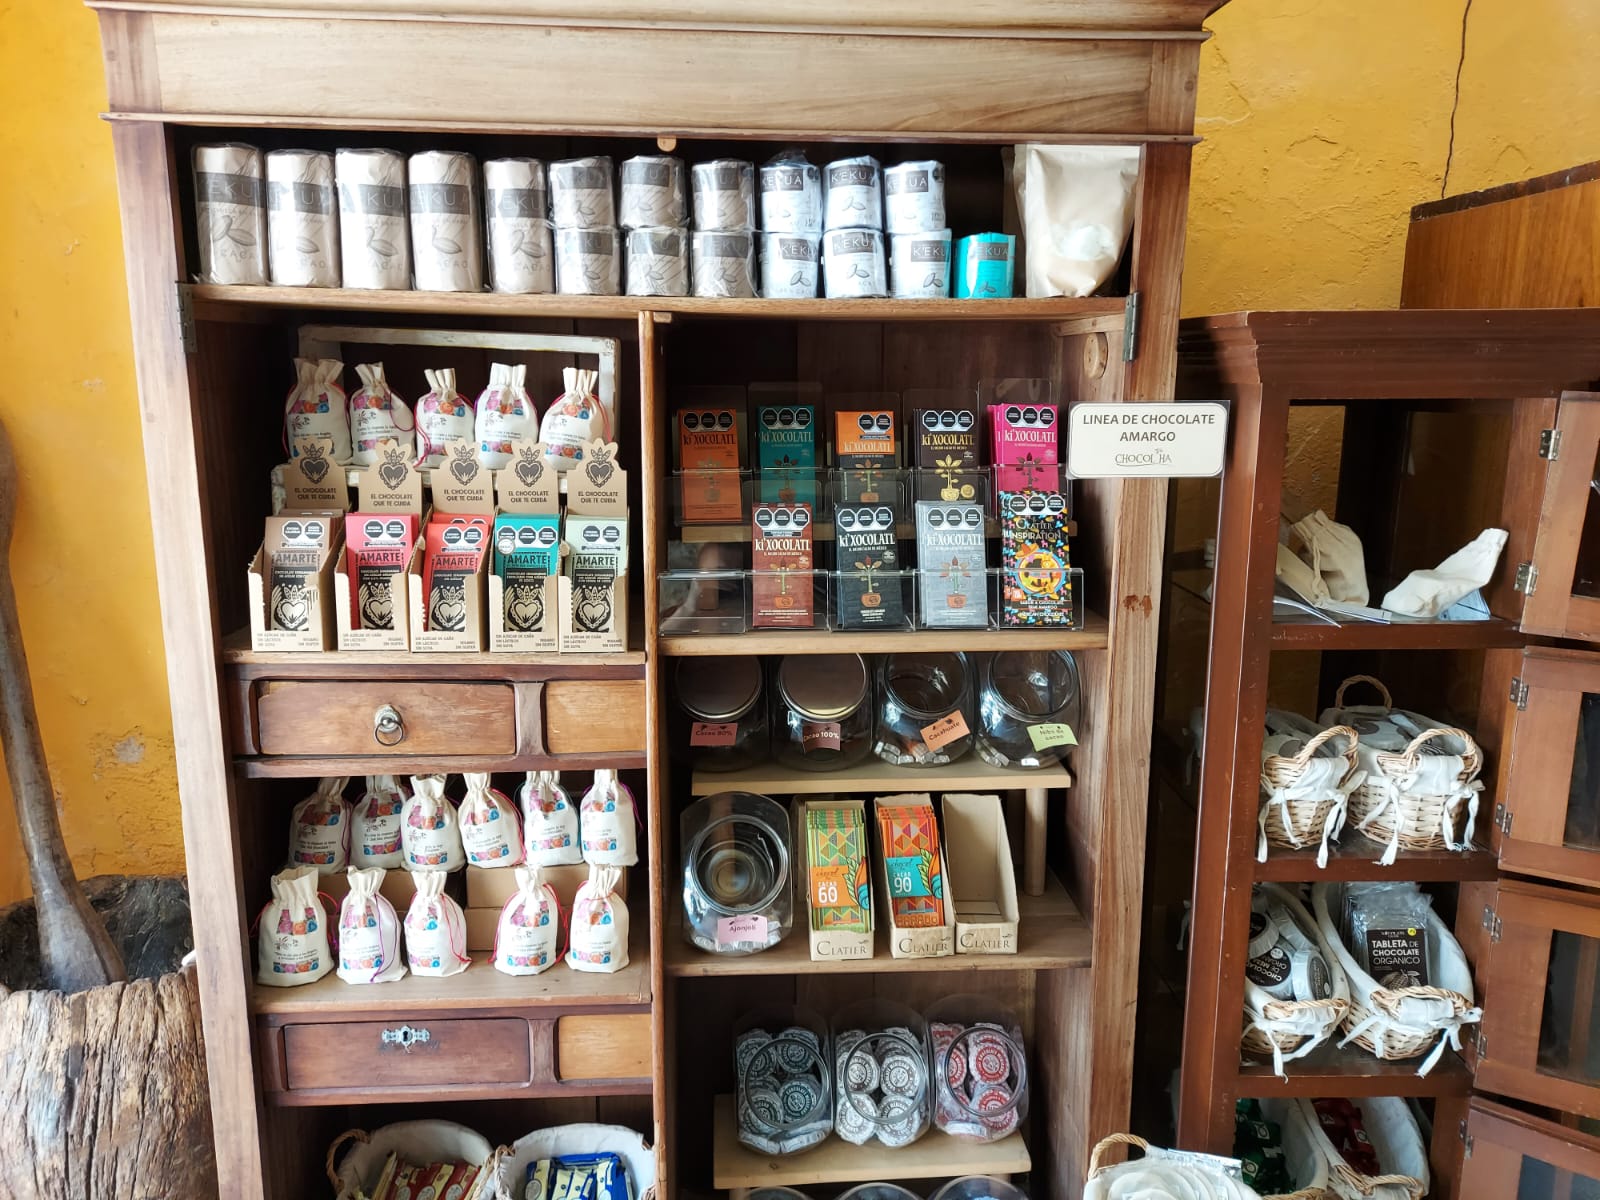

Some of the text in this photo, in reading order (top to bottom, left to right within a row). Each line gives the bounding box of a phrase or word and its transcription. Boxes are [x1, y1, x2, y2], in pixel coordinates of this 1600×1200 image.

[1083, 414, 1216, 425] LINEA DE CHOCOLATE
[1119, 431, 1176, 442] AMARGO
[276, 554, 316, 564] AMARTE
[360, 553, 400, 562] AMARTE
[436, 556, 474, 567] AMARTE
[507, 555, 546, 564] AMARTE
[576, 556, 615, 566] AMARTE
[820, 731, 839, 739] 100%
[929, 721, 960, 740] Cacahuate
[894, 877, 912, 893] 90
[818, 887, 838, 904] 60
[898, 938, 948, 953] CLATIER
[960, 933, 1010, 949] CLATIER
[1371, 940, 1408, 948] TABLETA
[816, 940, 867, 956] CLATIER
